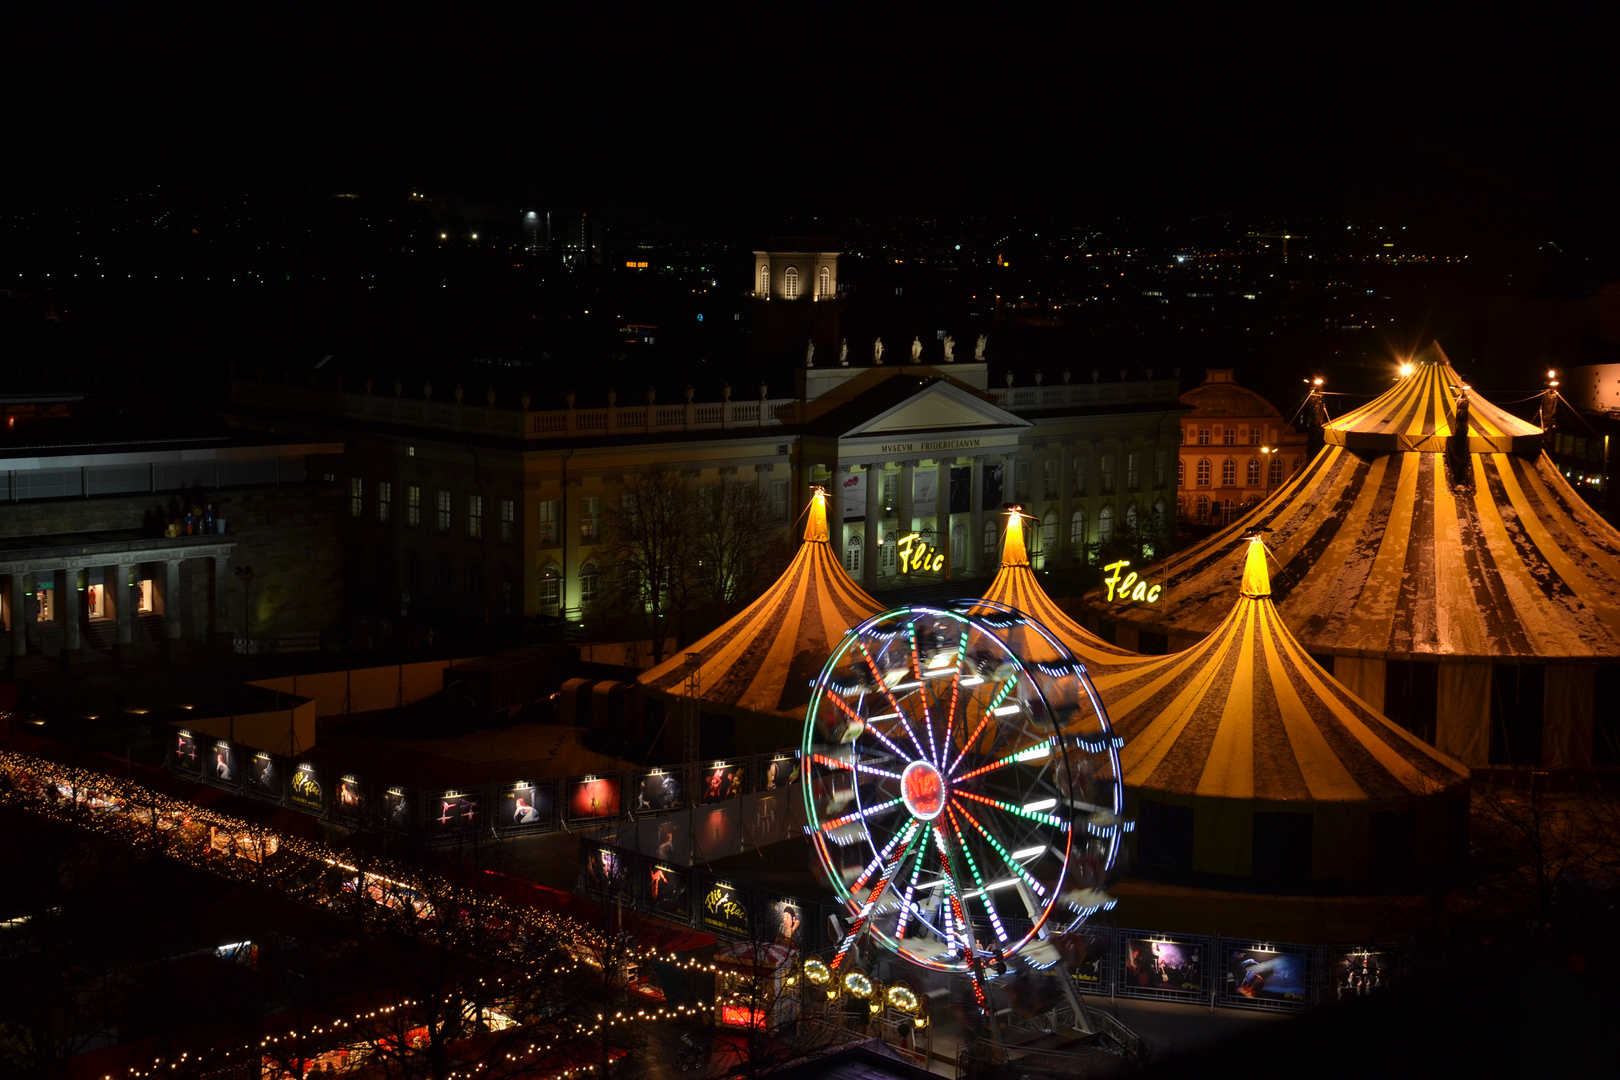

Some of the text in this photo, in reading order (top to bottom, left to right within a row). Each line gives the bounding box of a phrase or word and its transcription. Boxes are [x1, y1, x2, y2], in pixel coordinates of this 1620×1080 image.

[881, 439, 980, 453] MVSEVM FRIDERICIANVM
[897, 532, 945, 574] Flic
[1103, 559, 1162, 604] Flac
[704, 888, 722, 914] Flic
[723, 901, 746, 920] Flac
